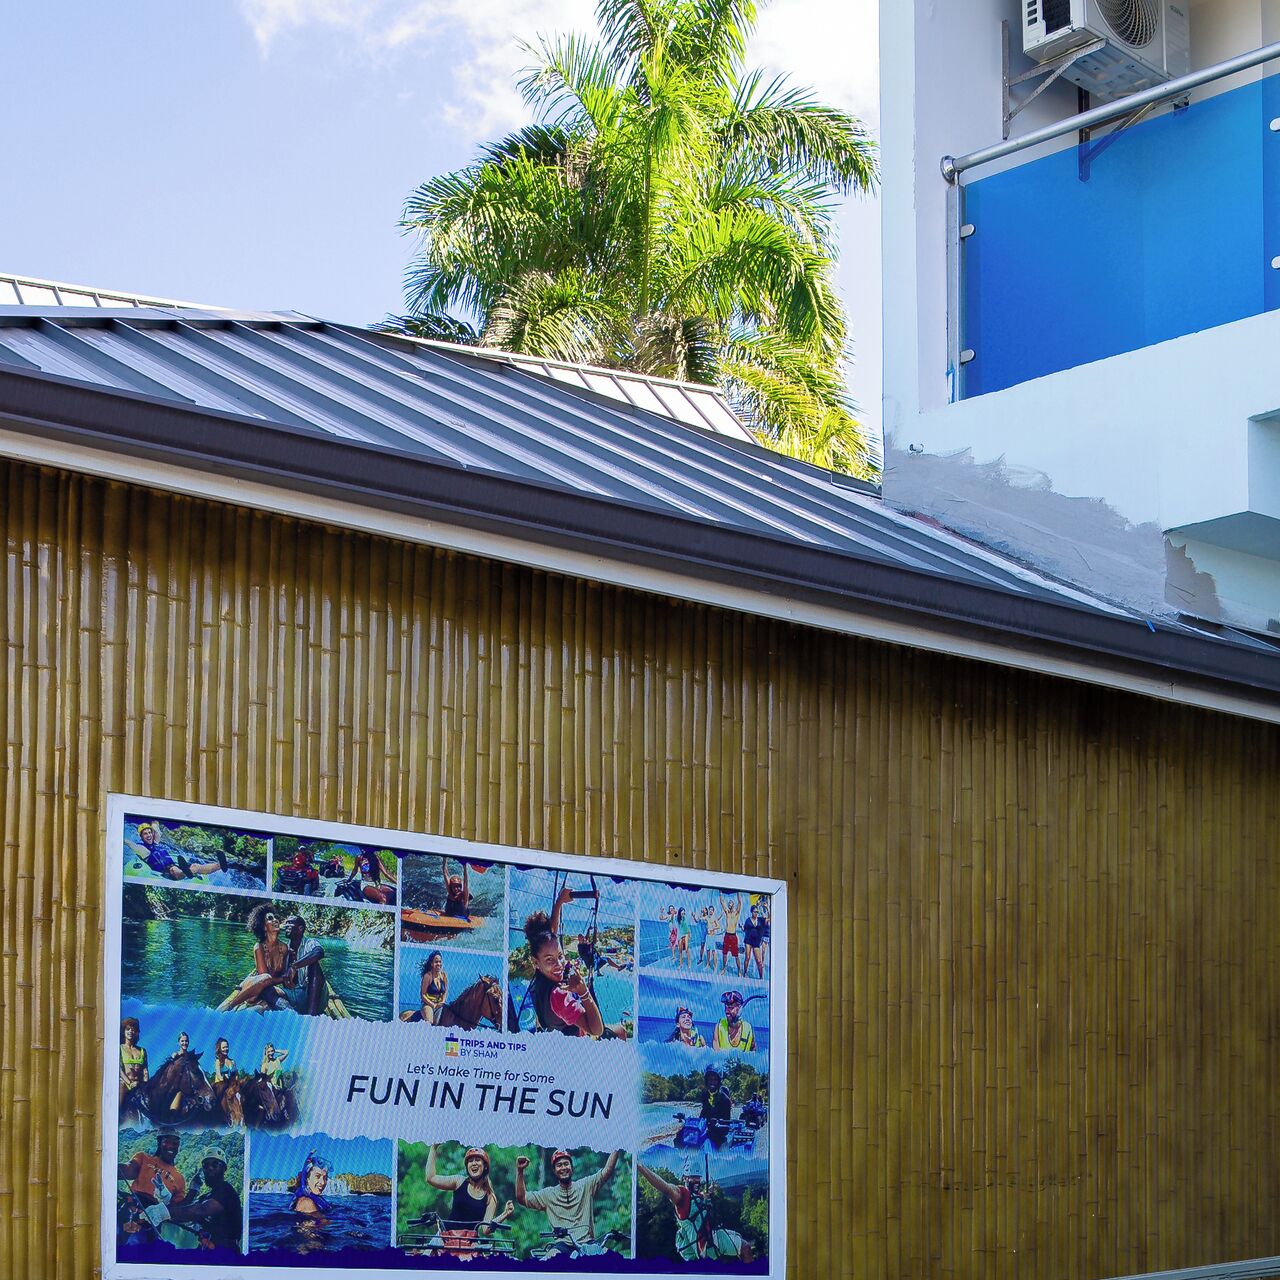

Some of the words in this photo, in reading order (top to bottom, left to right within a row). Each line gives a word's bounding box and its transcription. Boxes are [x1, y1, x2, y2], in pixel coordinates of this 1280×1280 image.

[460, 1038, 485, 1049] TRIPS
[486, 1041, 506, 1051] AND
[507, 1042, 527, 1052] TIPS
[460, 1049, 472, 1058] BY
[473, 1050, 498, 1060] SHAM
[407, 1063, 434, 1076] Let's
[437, 1065, 470, 1078] Make
[473, 1067, 502, 1081] Time
[504, 1069, 521, 1082] for
[522, 1071, 555, 1084] Some
[346, 1075, 420, 1107] FUN
[429, 1081, 465, 1110] IN
[475, 1083, 539, 1115] THE
[545, 1089, 614, 1120] SUN
